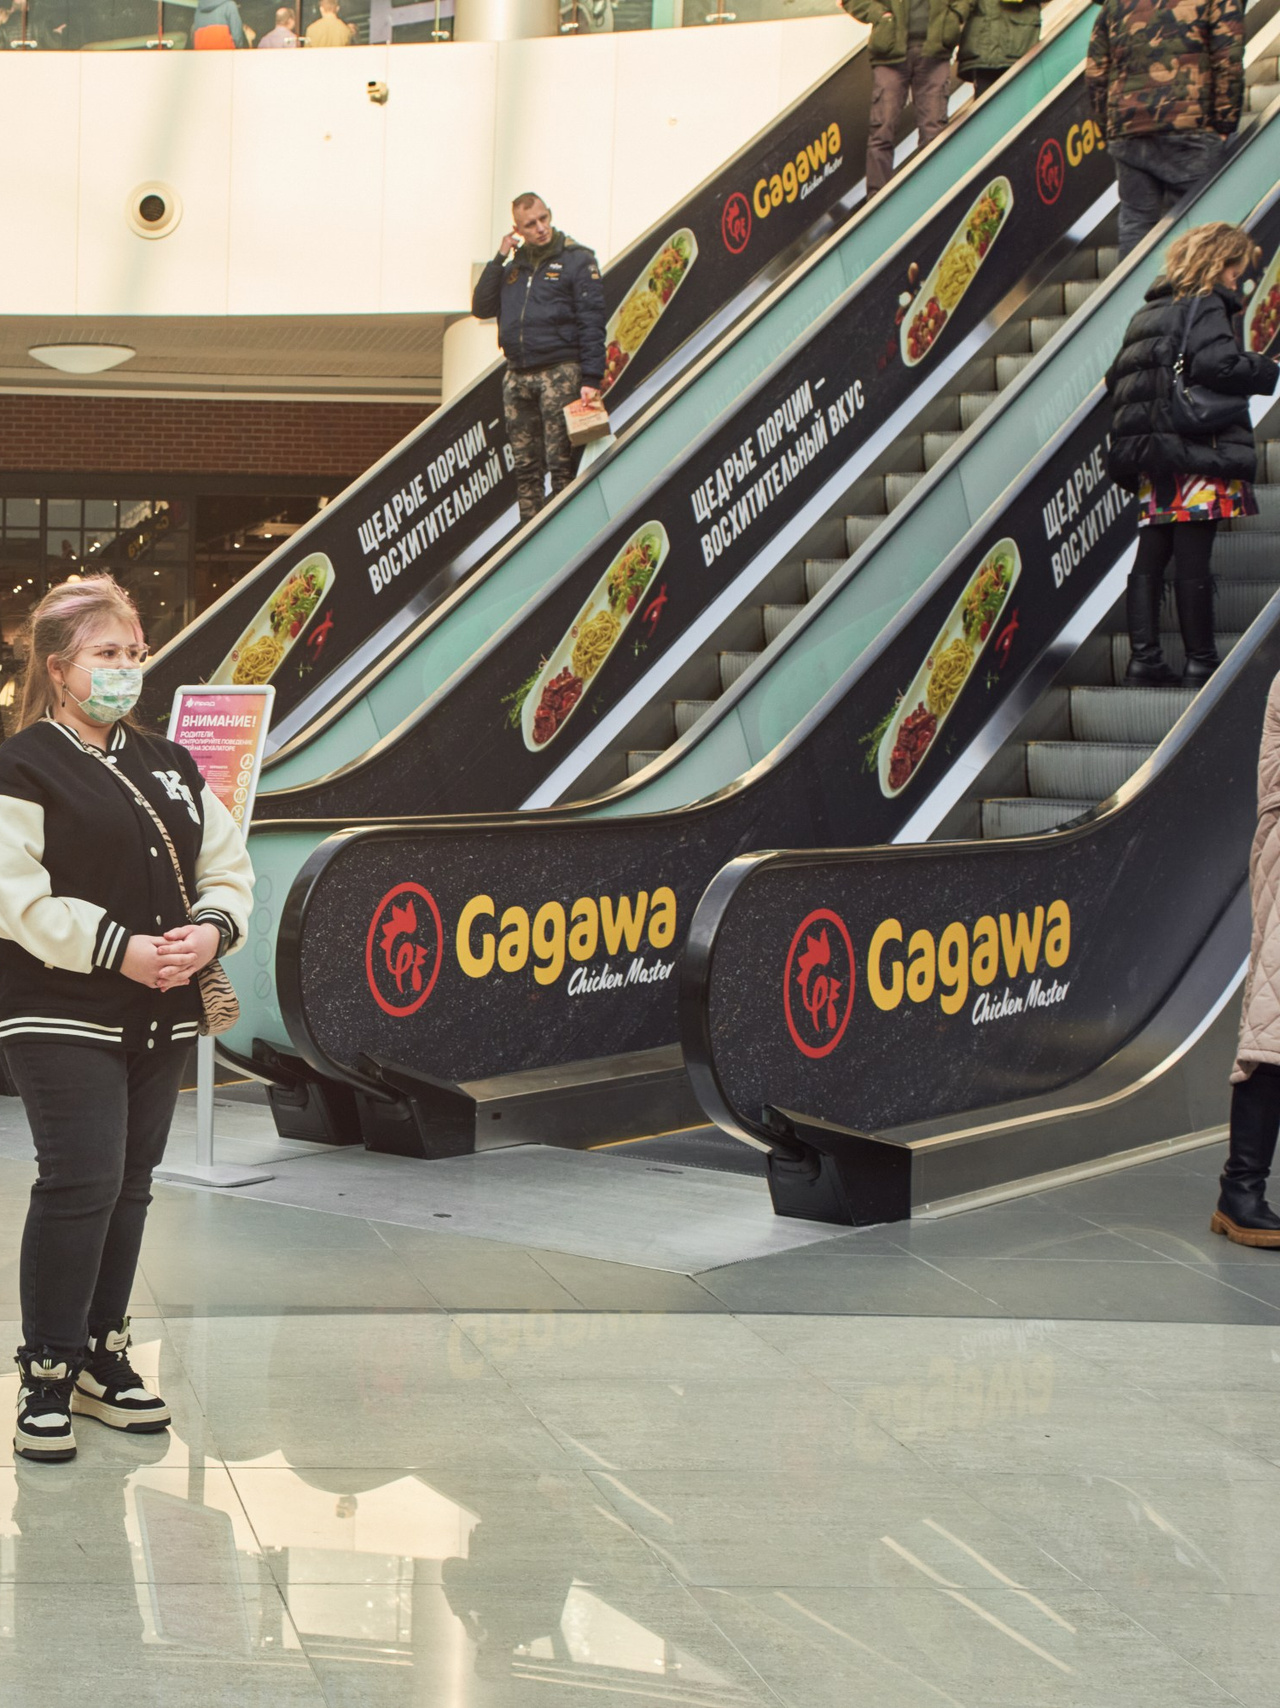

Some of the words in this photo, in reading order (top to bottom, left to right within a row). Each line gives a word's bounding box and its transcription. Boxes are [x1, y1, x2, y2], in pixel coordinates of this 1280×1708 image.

[753, 122, 841, 219] Gagawa
[800, 174, 824, 200] Chicken
[823, 156, 843, 179] Master
[357, 474, 427, 555] ЩЕДРЫЕ
[426, 420, 487, 493] ПОРЦИИ
[691, 437, 757, 524] ЩЕДРЫЕ
[756, 380, 813, 458] ПОРЦИИ
[700, 409, 828, 567] ВОСХИТИТЕЛЬНЫЙ
[827, 379, 865, 436] ВКУС
[1042, 444, 1106, 541] ЩЕДРЫЕ
[368, 447, 503, 595] ВОСХИТИТЕЛЬНЫЙ
[1051, 482, 1134, 589] ВОСХИТИТЕ
[182, 714, 257, 728] ВНИМАНИЕ!
[456, 886, 677, 986] Gagawa
[567, 963, 623, 997] Chicken
[623, 957, 676, 988] Master
[867, 899, 1071, 1015] Gagawa
[971, 987, 1023, 1026] Chicken
[1022, 978, 1070, 1013] Master
